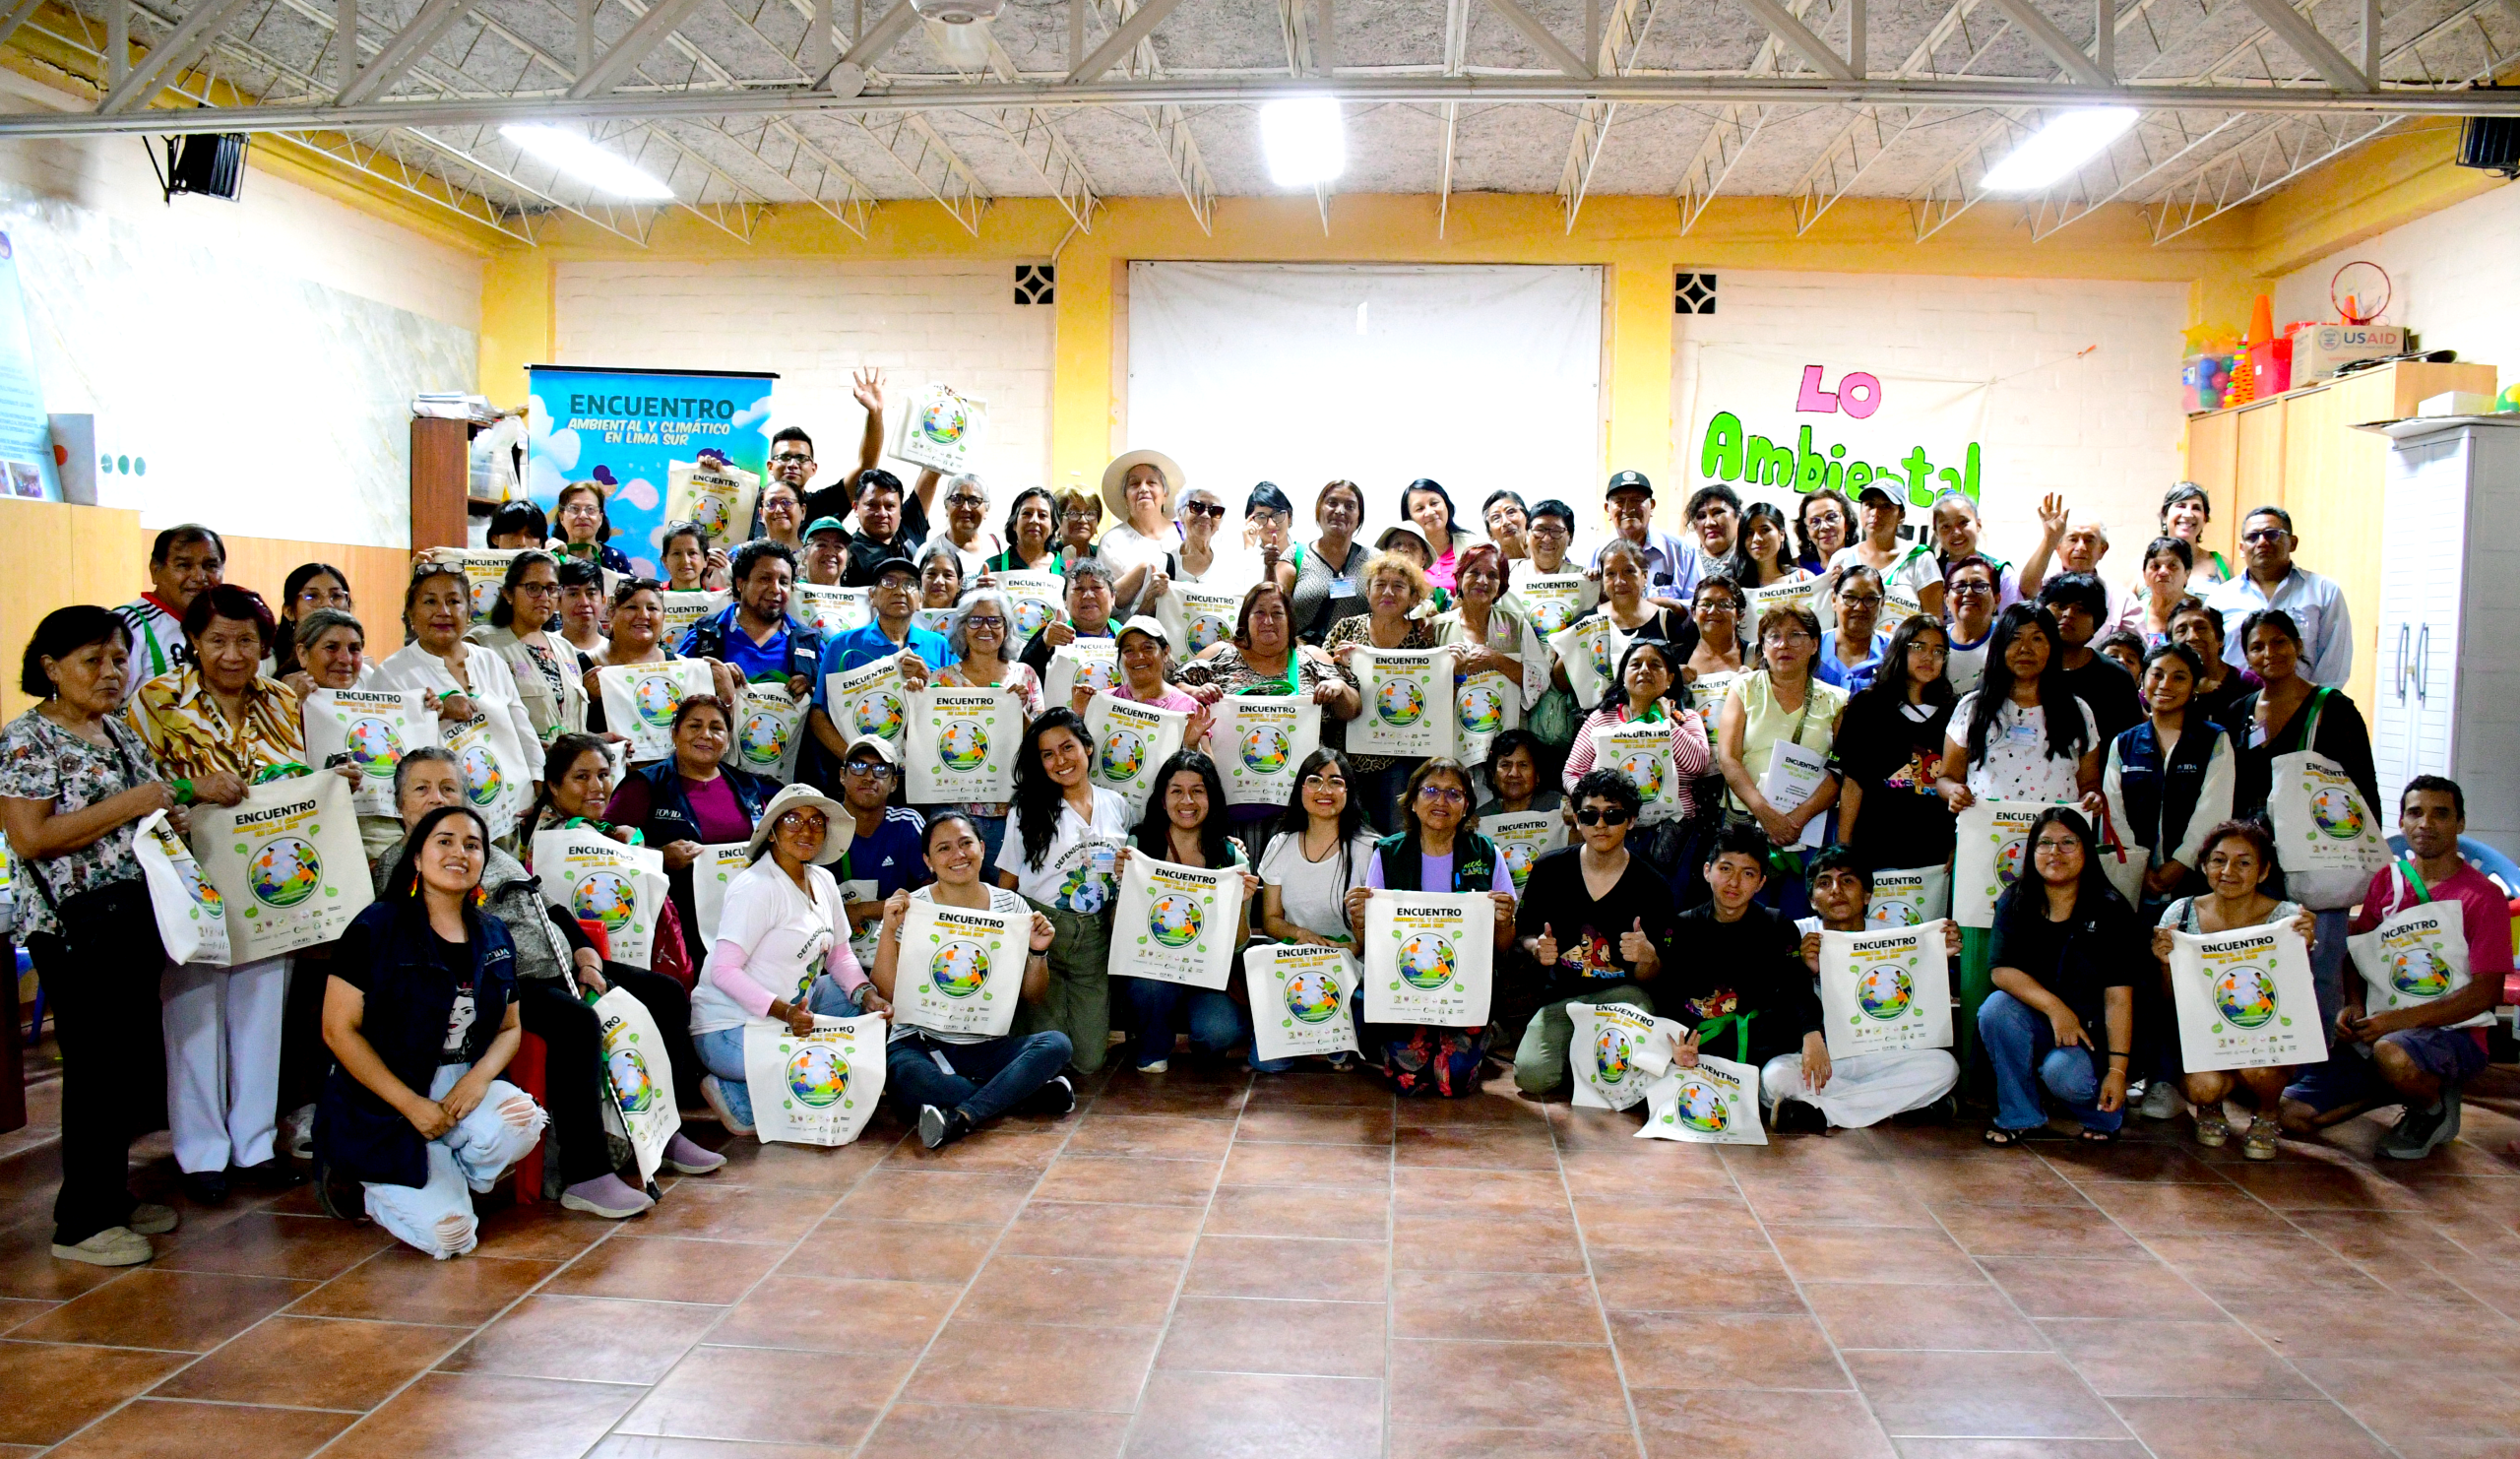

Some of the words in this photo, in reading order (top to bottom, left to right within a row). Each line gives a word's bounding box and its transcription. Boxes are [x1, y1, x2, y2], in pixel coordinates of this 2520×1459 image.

[2344, 332, 2397, 345] USAID
[1796, 364, 1881, 419] LO
[570, 394, 734, 419] ENCUENTRO
[567, 417, 643, 433] AMBIENTAL
[648, 420, 657, 432] Y
[660, 418, 730, 435] CLIMÁTICO
[604, 431, 622, 444] EN
[626, 433, 658, 445] LIMA
[662, 433, 689, 446] SUR
[693, 475, 740, 488] ENCUENTRO
[804, 592, 854, 602] ENCUENTRO
[1759, 586, 1811, 598] ENCUENTRO
[1186, 595, 1234, 605] ENCUENTRO
[1885, 596, 1922, 611] ENCUENT
[1575, 615, 1609, 631] ENCUEN
[843, 666, 895, 689] ENCUENTRO
[1692, 679, 1731, 689] ENCUEN
[336, 691, 402, 704] ENCUENTRO
[748, 692, 796, 710] ENCUENT
[1112, 705, 1161, 723] ENCUENTRO
[443, 713, 486, 742] CUENTRO
[1786, 757, 1819, 772] ENCUENTRO
[2306, 763, 2347, 777] ENCUENT
[235, 799, 316, 825] ENCUENTRO
[1996, 811, 2038, 820] ENCUEN
[1497, 821, 1547, 833] ENCUENTRO
[1156, 868, 1217, 884] ENCUENTRO
[1874, 876, 1922, 886] CUENTRO
[1398, 908, 1462, 917] ENCUENTRO
[939, 913, 1004, 928] ENCUENTRO
[2382, 920, 2438, 942] NCENTRO
[1854, 936, 1917, 951] ENCUENTRO
[2202, 936, 2274, 953] ENCUENTRO
[1277, 948, 1338, 958] ENCUENTRO
[1559, 958, 1583, 971] OCES
[1596, 1004, 1655, 1027] ENCUENTRO
[785, 1025, 855, 1034] EENTRO
[1695, 1062, 1740, 1084] UENTRO
